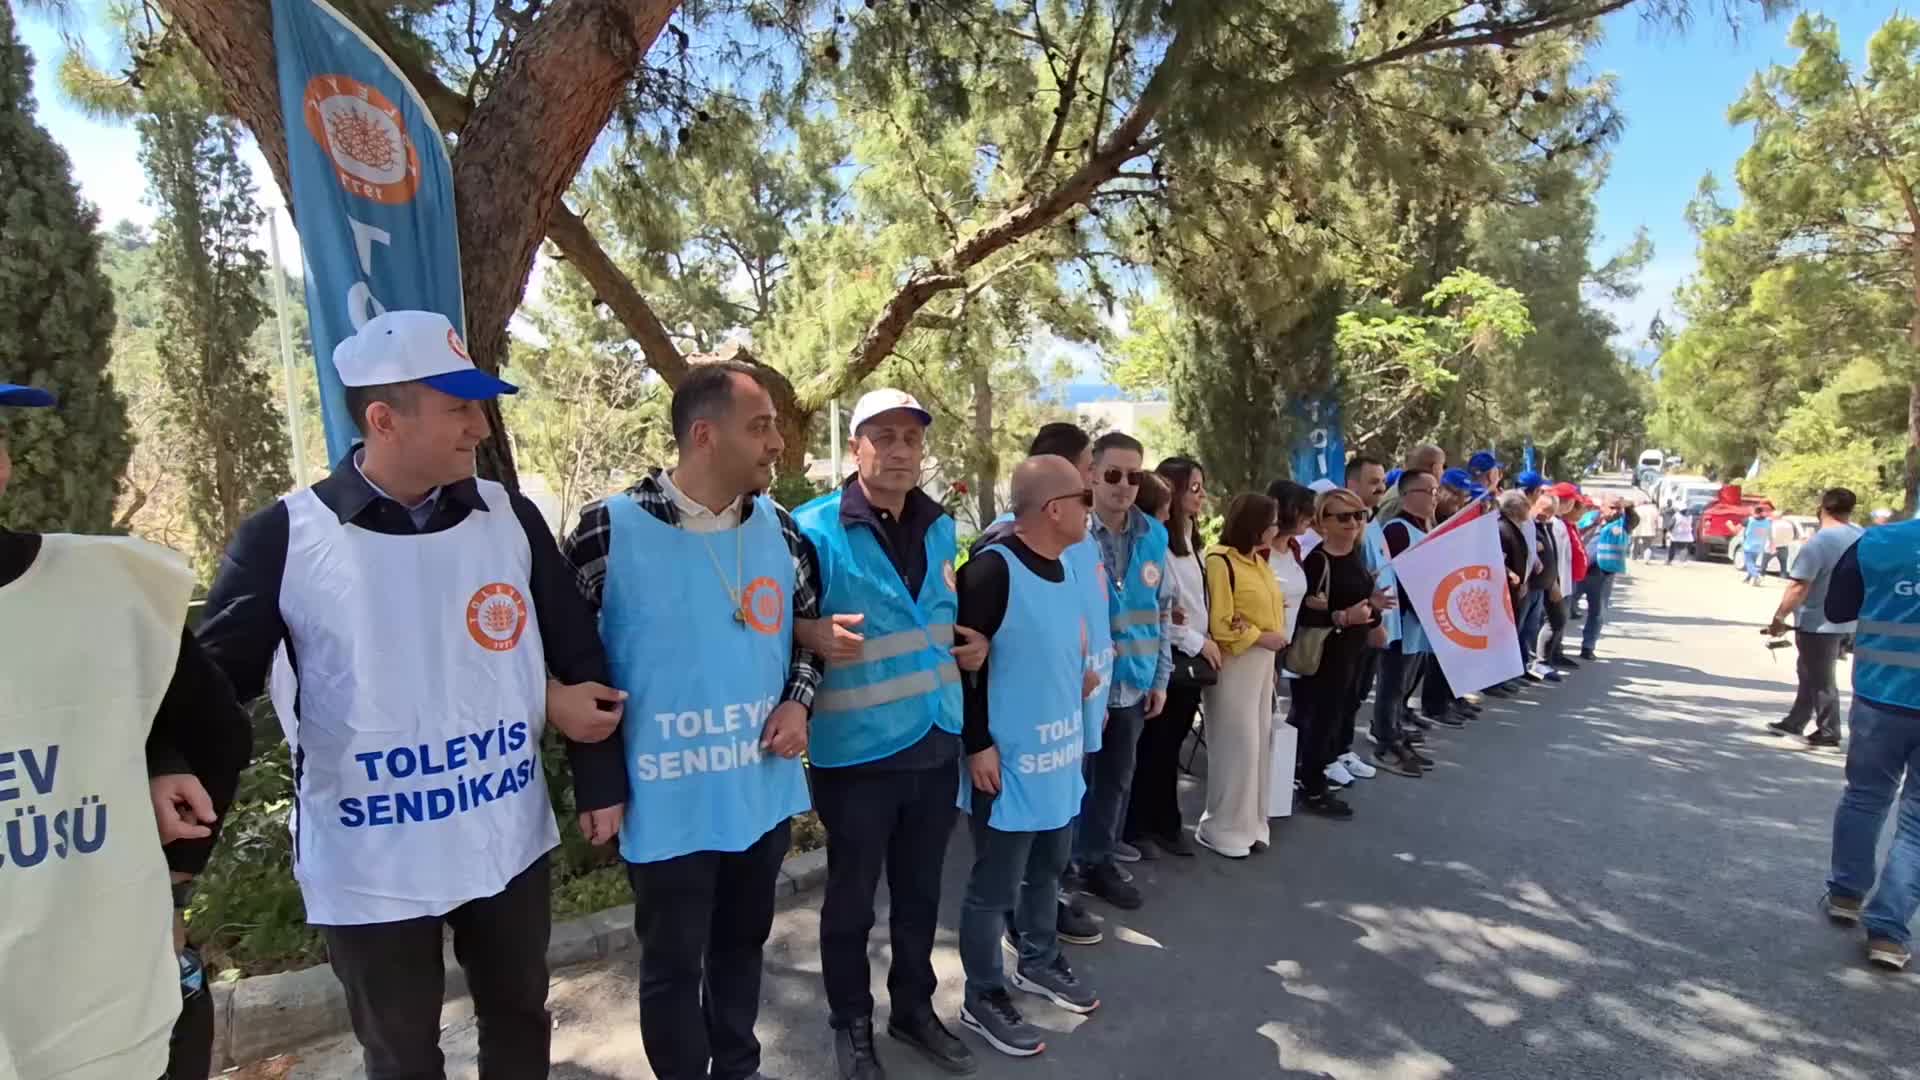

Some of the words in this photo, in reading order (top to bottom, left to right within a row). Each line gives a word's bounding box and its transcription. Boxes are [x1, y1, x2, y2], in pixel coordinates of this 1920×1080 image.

[355, 719, 528, 782] TOLEYİS
[338, 754, 537, 828] SENDİKASI
[0, 795, 107, 868] ÜSÜ
